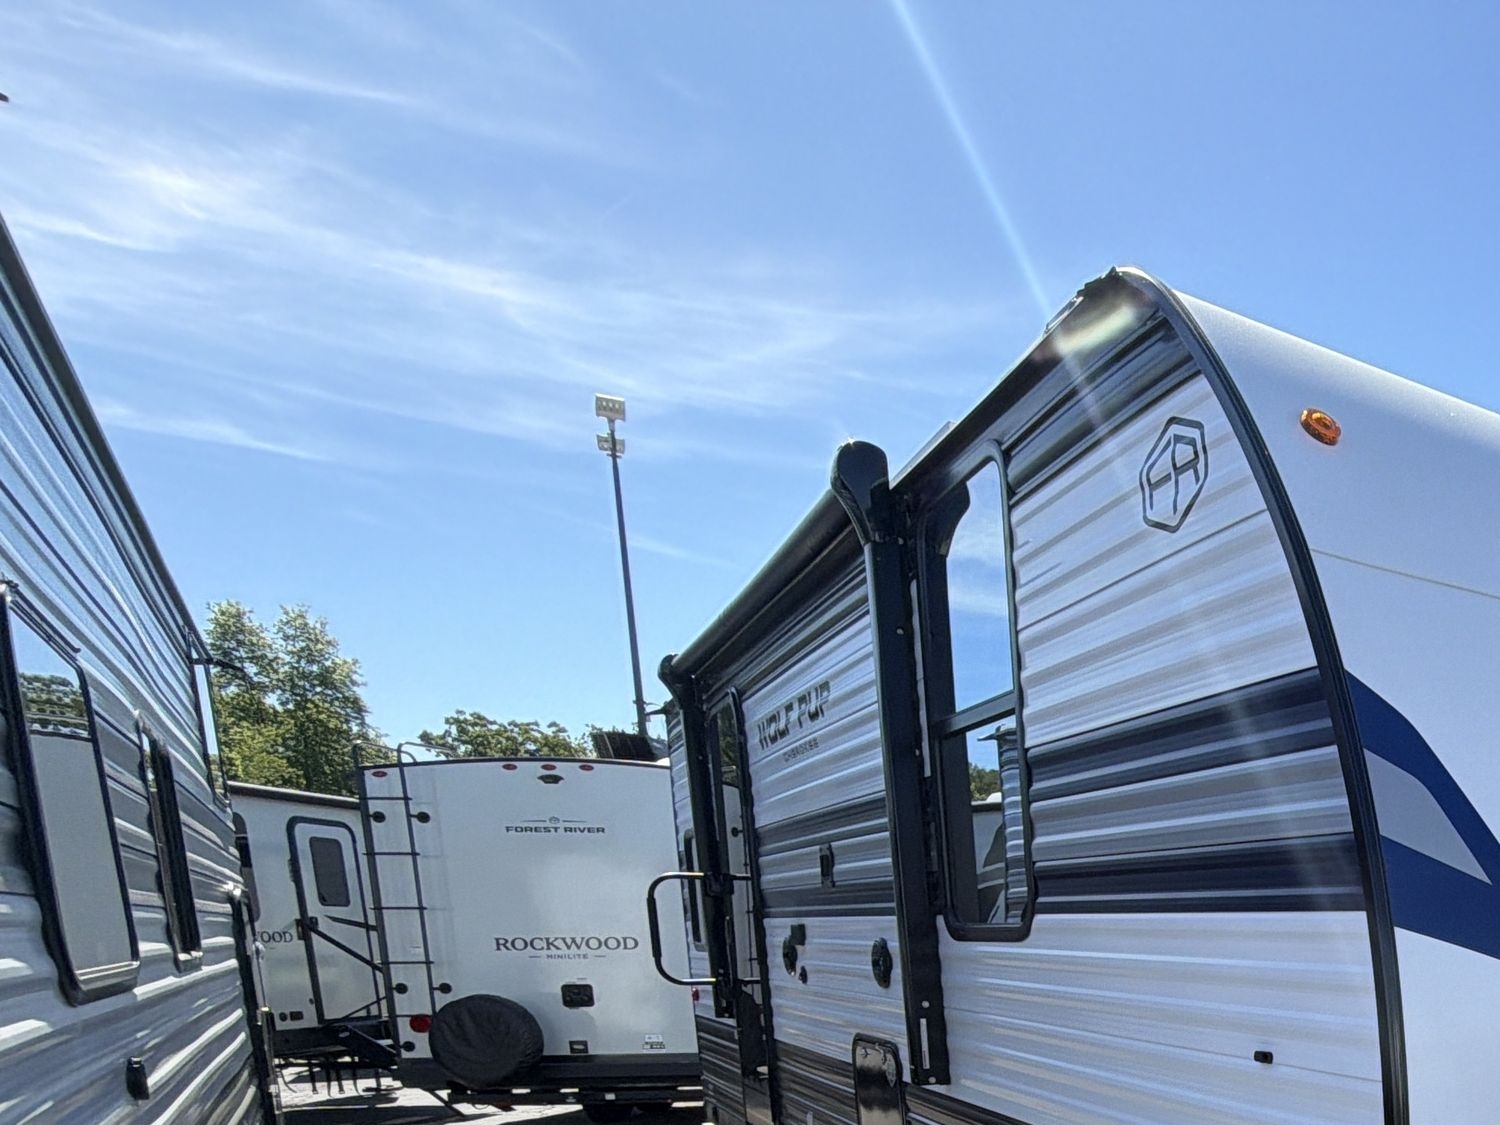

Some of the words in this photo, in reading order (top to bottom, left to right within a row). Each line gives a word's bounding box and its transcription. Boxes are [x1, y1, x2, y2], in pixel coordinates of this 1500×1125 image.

[757, 701, 794, 751] WOLF
[796, 680, 831, 729] PUP
[504, 825, 561, 834] FOREST
[563, 826, 606, 834] RIVER
[493, 936, 640, 952] ROCKWOOD
